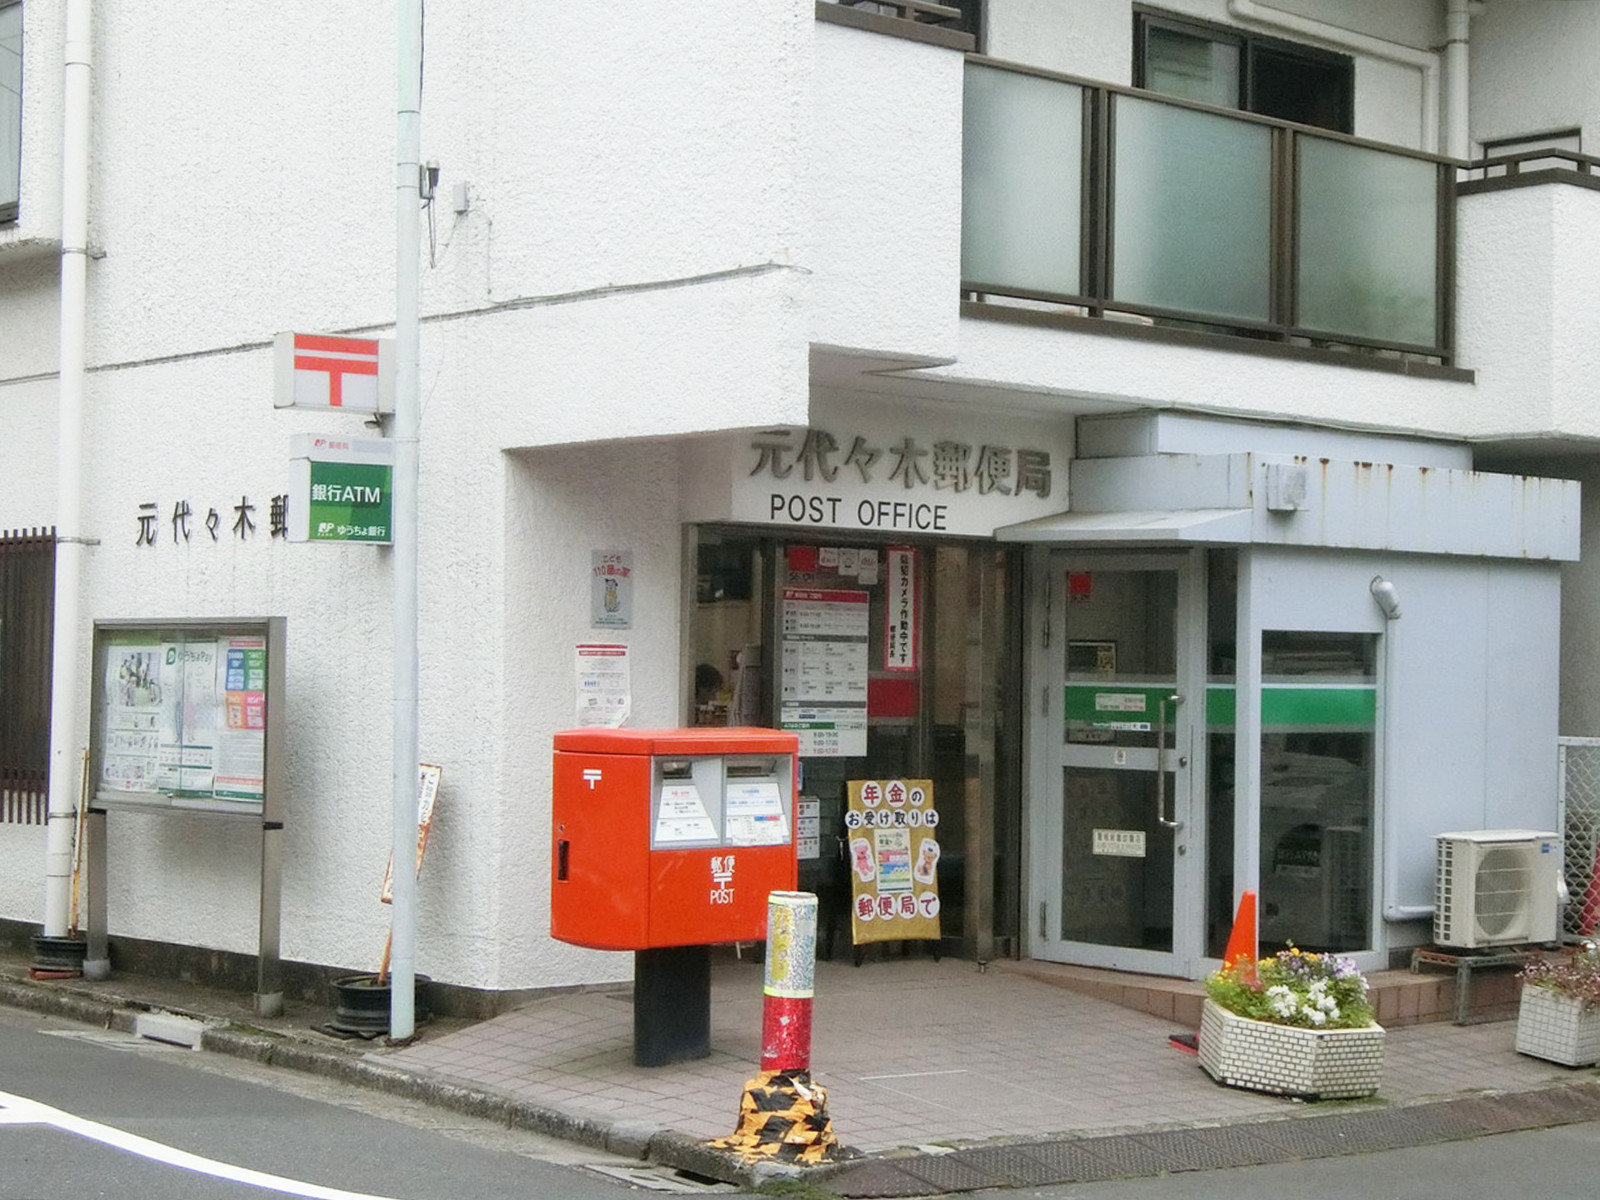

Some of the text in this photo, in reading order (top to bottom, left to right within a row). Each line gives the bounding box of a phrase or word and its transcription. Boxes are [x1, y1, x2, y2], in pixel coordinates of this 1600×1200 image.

[750, 430, 1051, 498] 元代々木郵便局
[312, 484, 380, 503] 銀行ATM
[771, 494, 947, 531] POST OFFICE
[337, 525, 386, 537] ゆうちょ銀行
[863, 783, 922, 804] 年金の
[847, 810, 937, 826] お受け取りは
[710, 855, 736, 874] 郵便
[710, 889, 735, 904] POST
[857, 896, 937, 917] 郵便局で
